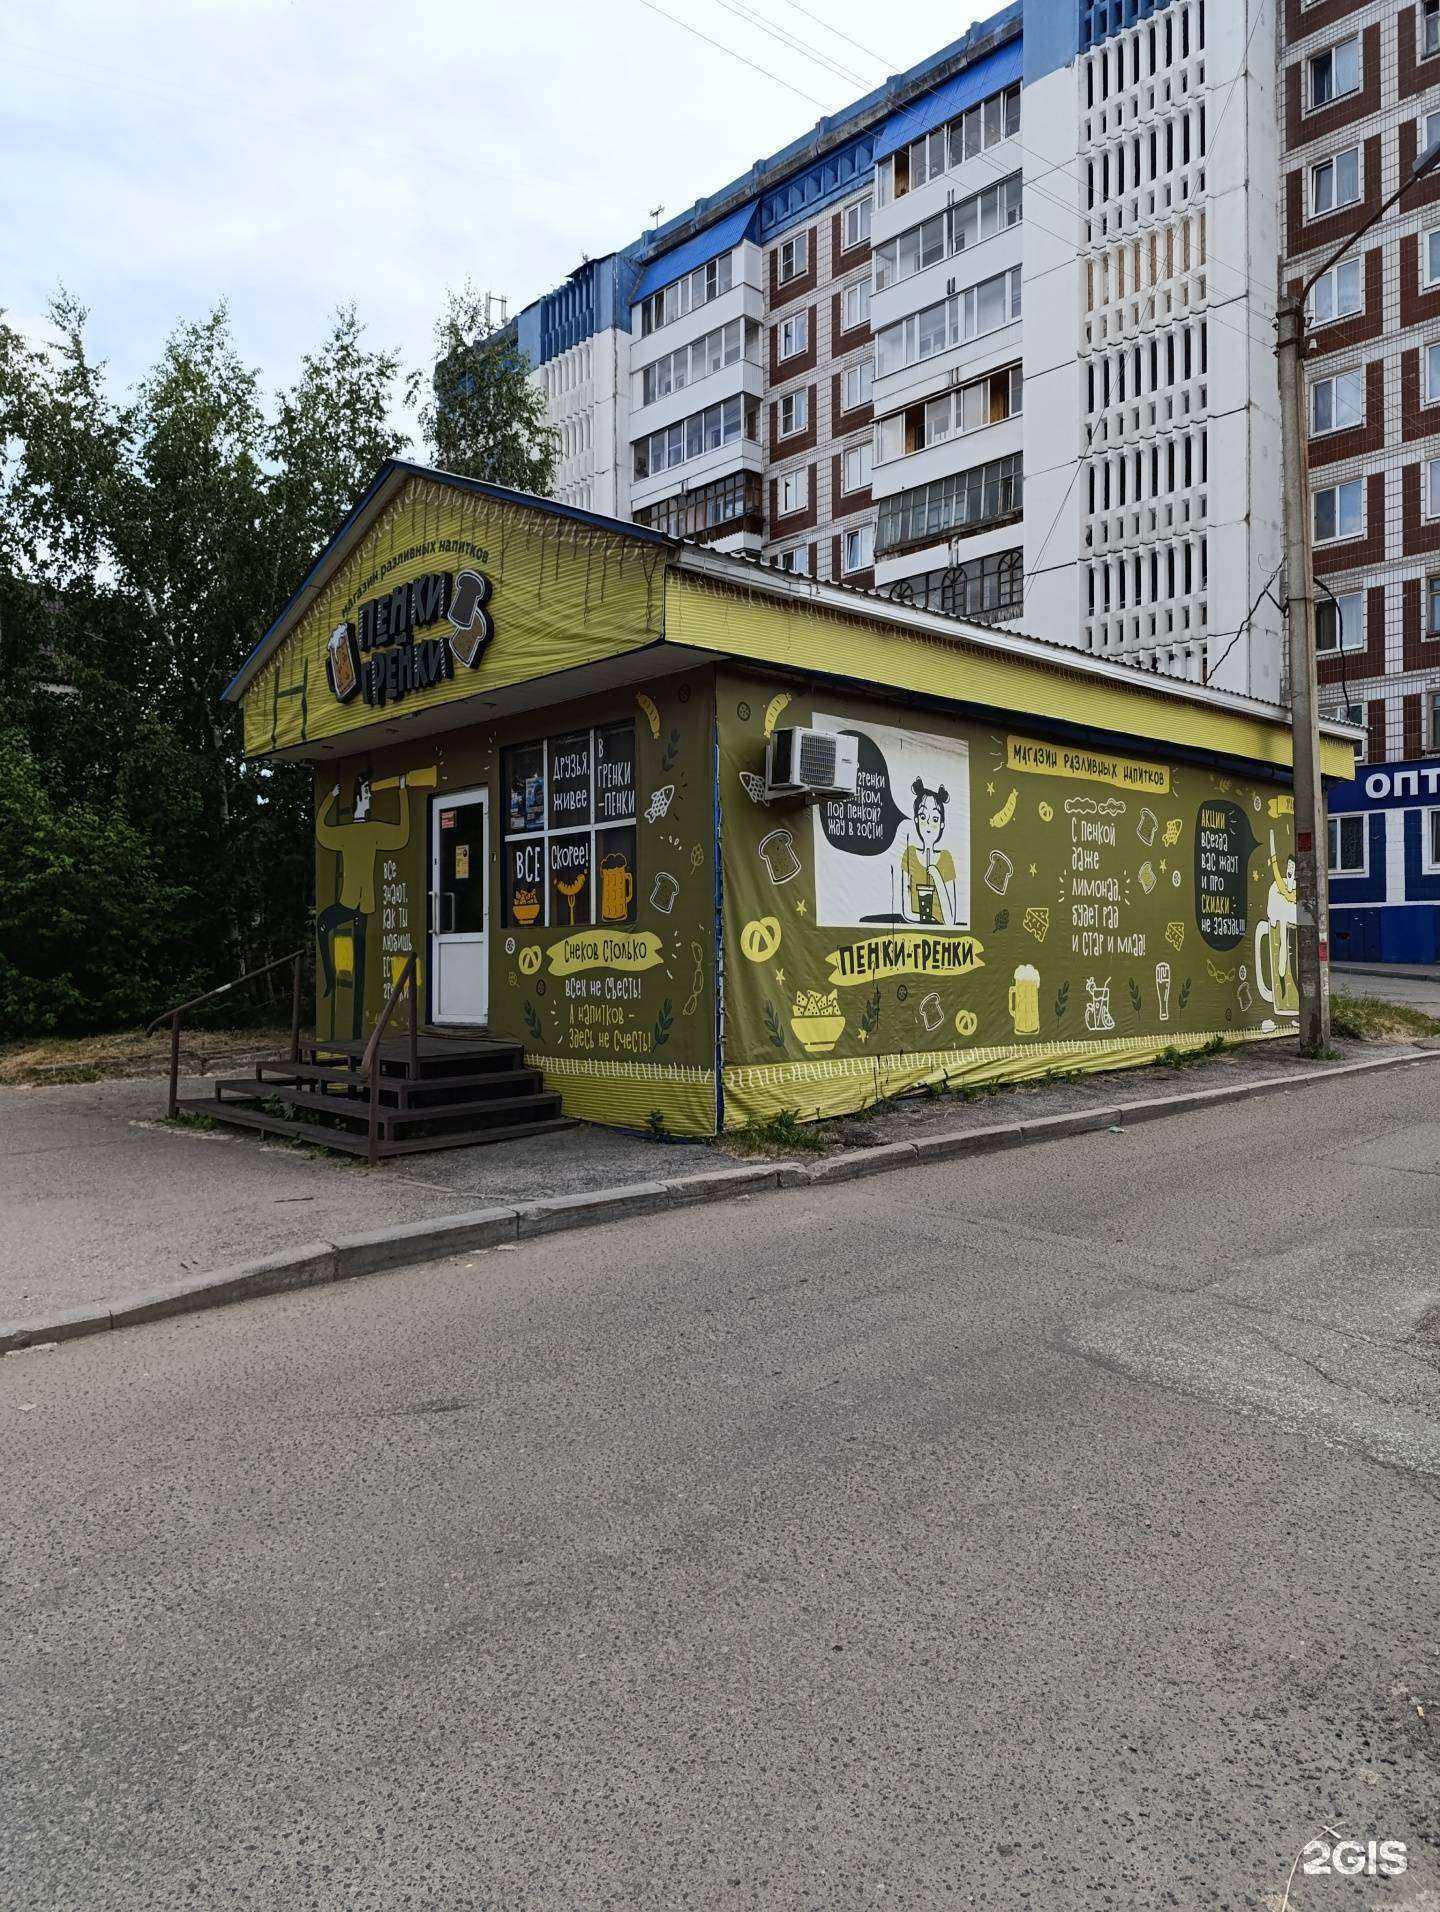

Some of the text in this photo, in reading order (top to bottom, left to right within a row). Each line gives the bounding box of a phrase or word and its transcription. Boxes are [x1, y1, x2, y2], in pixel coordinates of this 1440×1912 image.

[380, 540, 436, 580] разливных
[439, 540, 489, 563] напитков
[358, 571, 452, 651] ПЕНКИ
[361, 637, 454, 707] ГРЕНКИ
[597, 761, 631, 788] ГРЕНКИ
[1013, 744, 1165, 786] МАГАЗИН РАЗЛИВНЫХ НАПИТКОВ
[1201, 809, 1226, 830] АКЦИИ
[516, 846, 540, 882] ВСЕ
[1201, 895, 1230, 914] СКИДКИ
